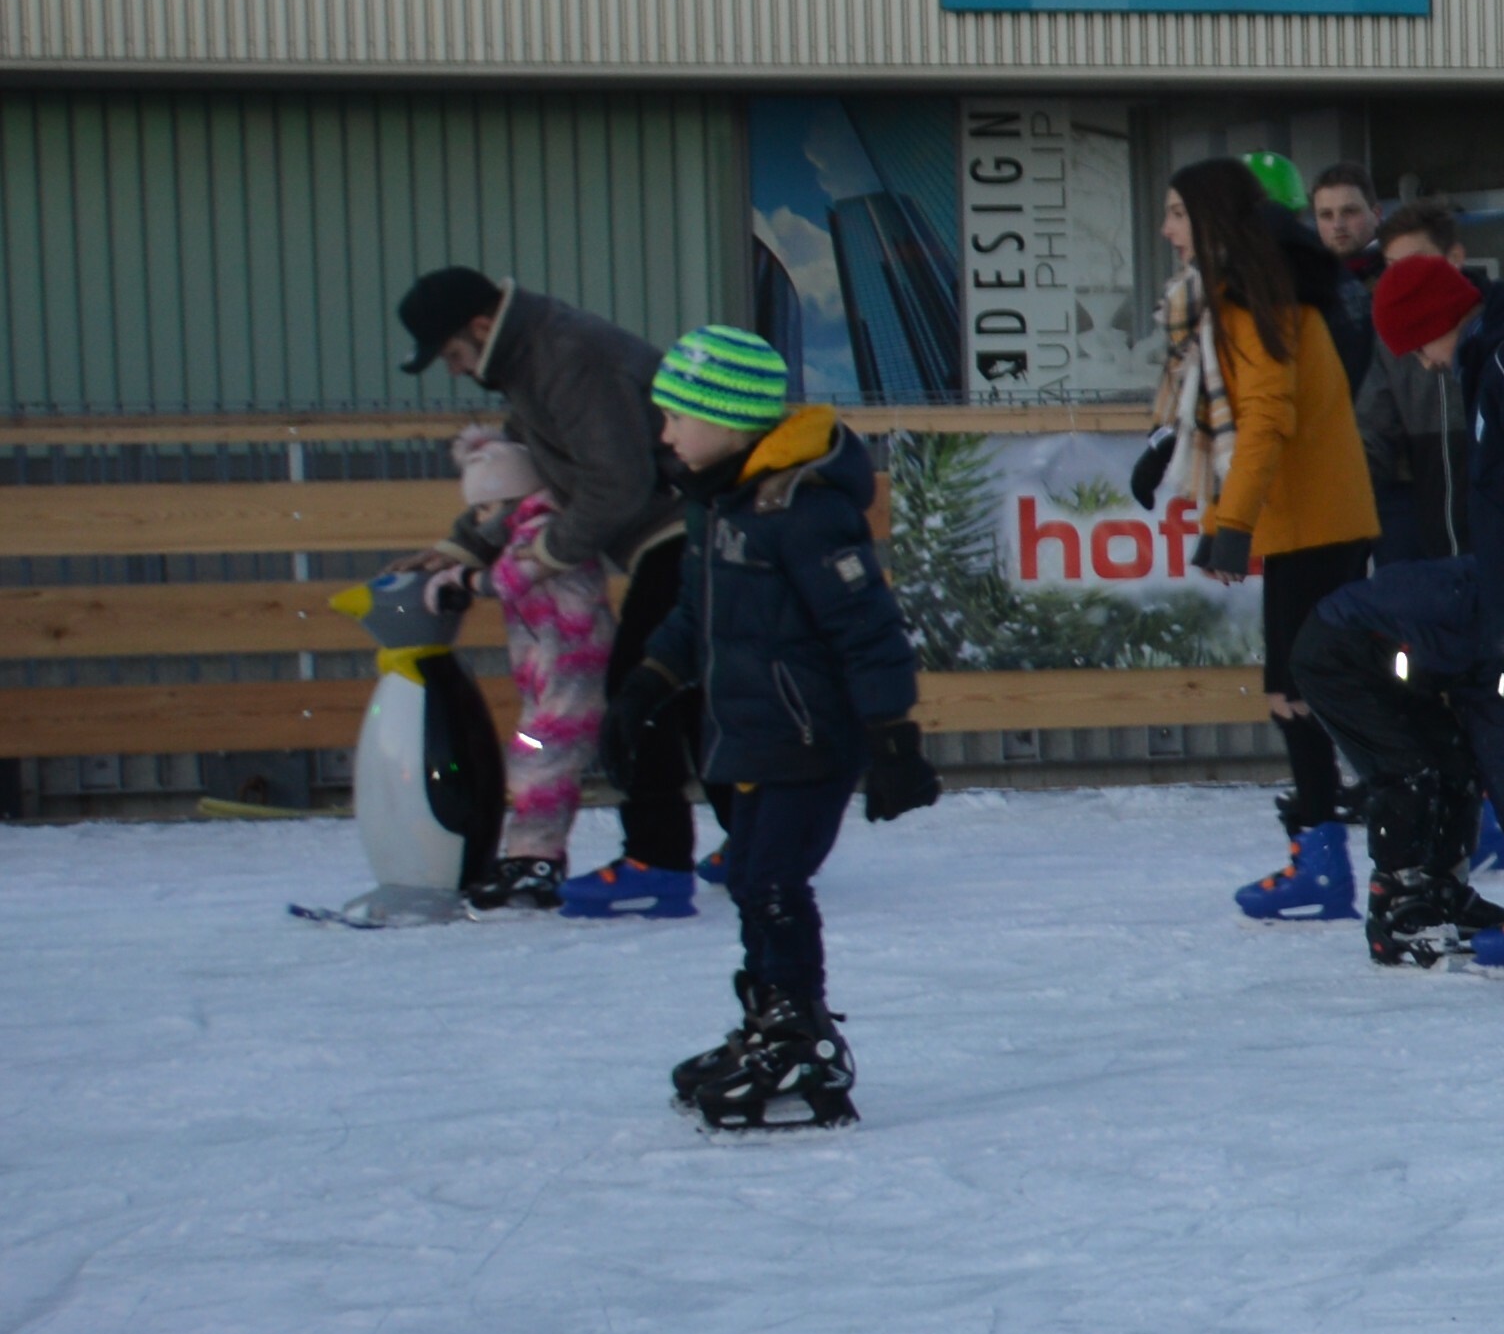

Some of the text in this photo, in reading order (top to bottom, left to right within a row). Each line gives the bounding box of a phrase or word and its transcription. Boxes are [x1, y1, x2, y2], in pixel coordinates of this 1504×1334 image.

[968, 111, 1027, 335] DESIGN
[1030, 111, 1072, 404] AUL PHILLIP
